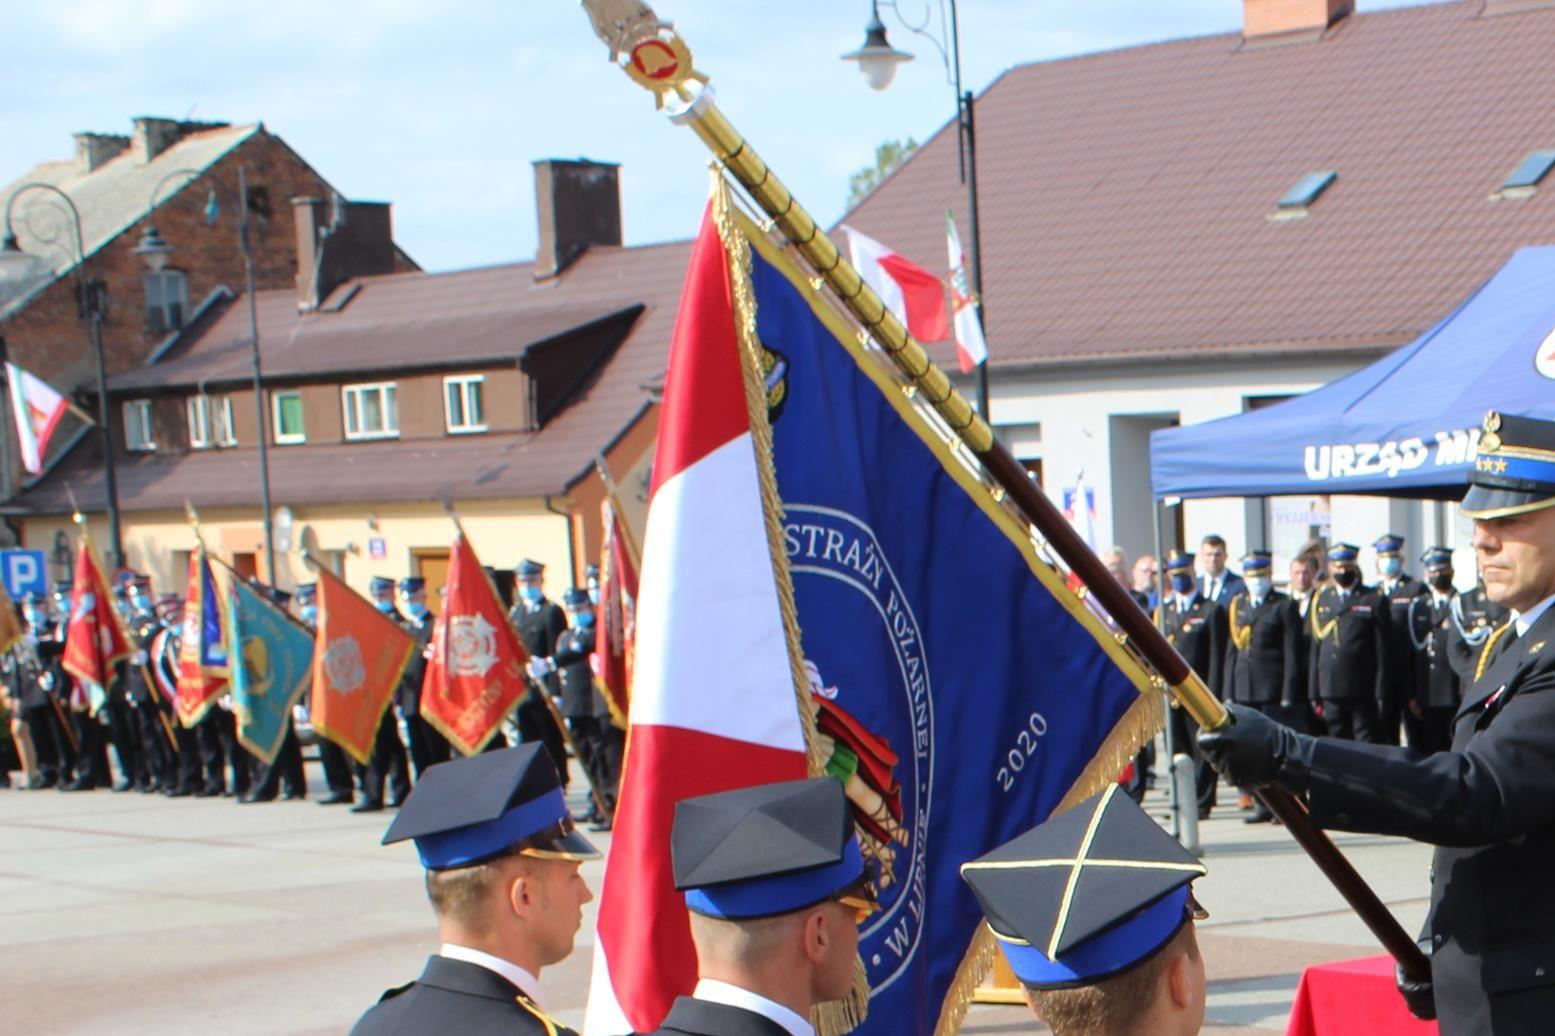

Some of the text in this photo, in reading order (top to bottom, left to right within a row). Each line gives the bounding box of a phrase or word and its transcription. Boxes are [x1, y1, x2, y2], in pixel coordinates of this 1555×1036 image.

[1304, 437, 1428, 480] URZĄD
[9, 554, 37, 594] P
[783, 523, 929, 759] STRAŻY POŻARNEJ
[996, 711, 1048, 792] 2020
[884, 928, 911, 958] W
